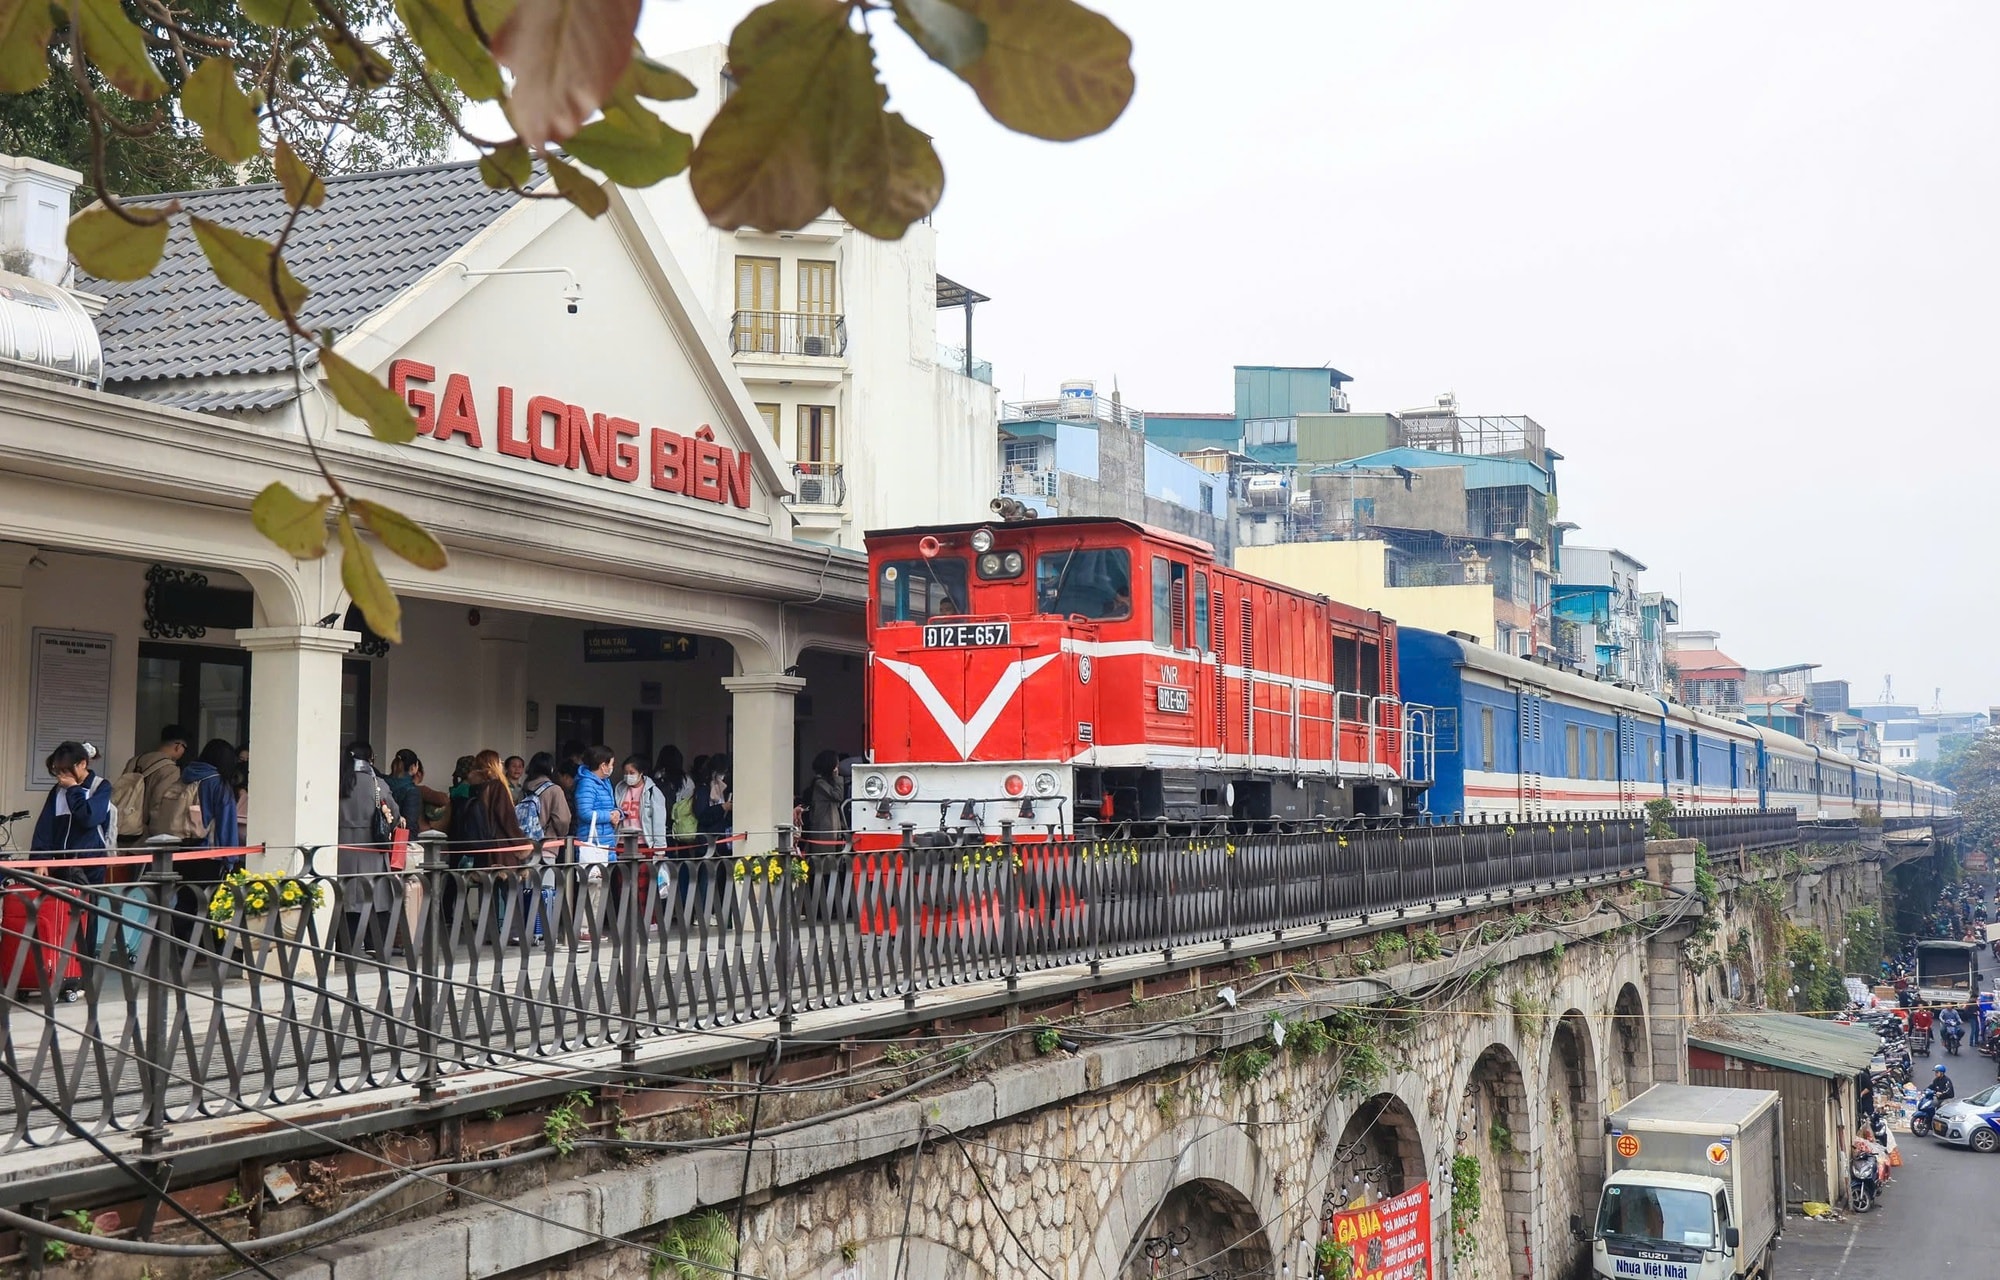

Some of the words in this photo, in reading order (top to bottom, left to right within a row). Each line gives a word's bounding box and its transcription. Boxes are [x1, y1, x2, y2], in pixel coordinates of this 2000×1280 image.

[388, 358, 482, 449] GA
[498, 386, 640, 482] LONG
[651, 423, 752, 509] BIÊN
[1160, 664, 1178, 685] VNR
[1638, 1251, 1669, 1260] ISUZU
[1616, 1259, 1641, 1277] Nhựa
[1643, 1261, 1662, 1279] Việt
[1664, 1264, 1687, 1280] Nhật
